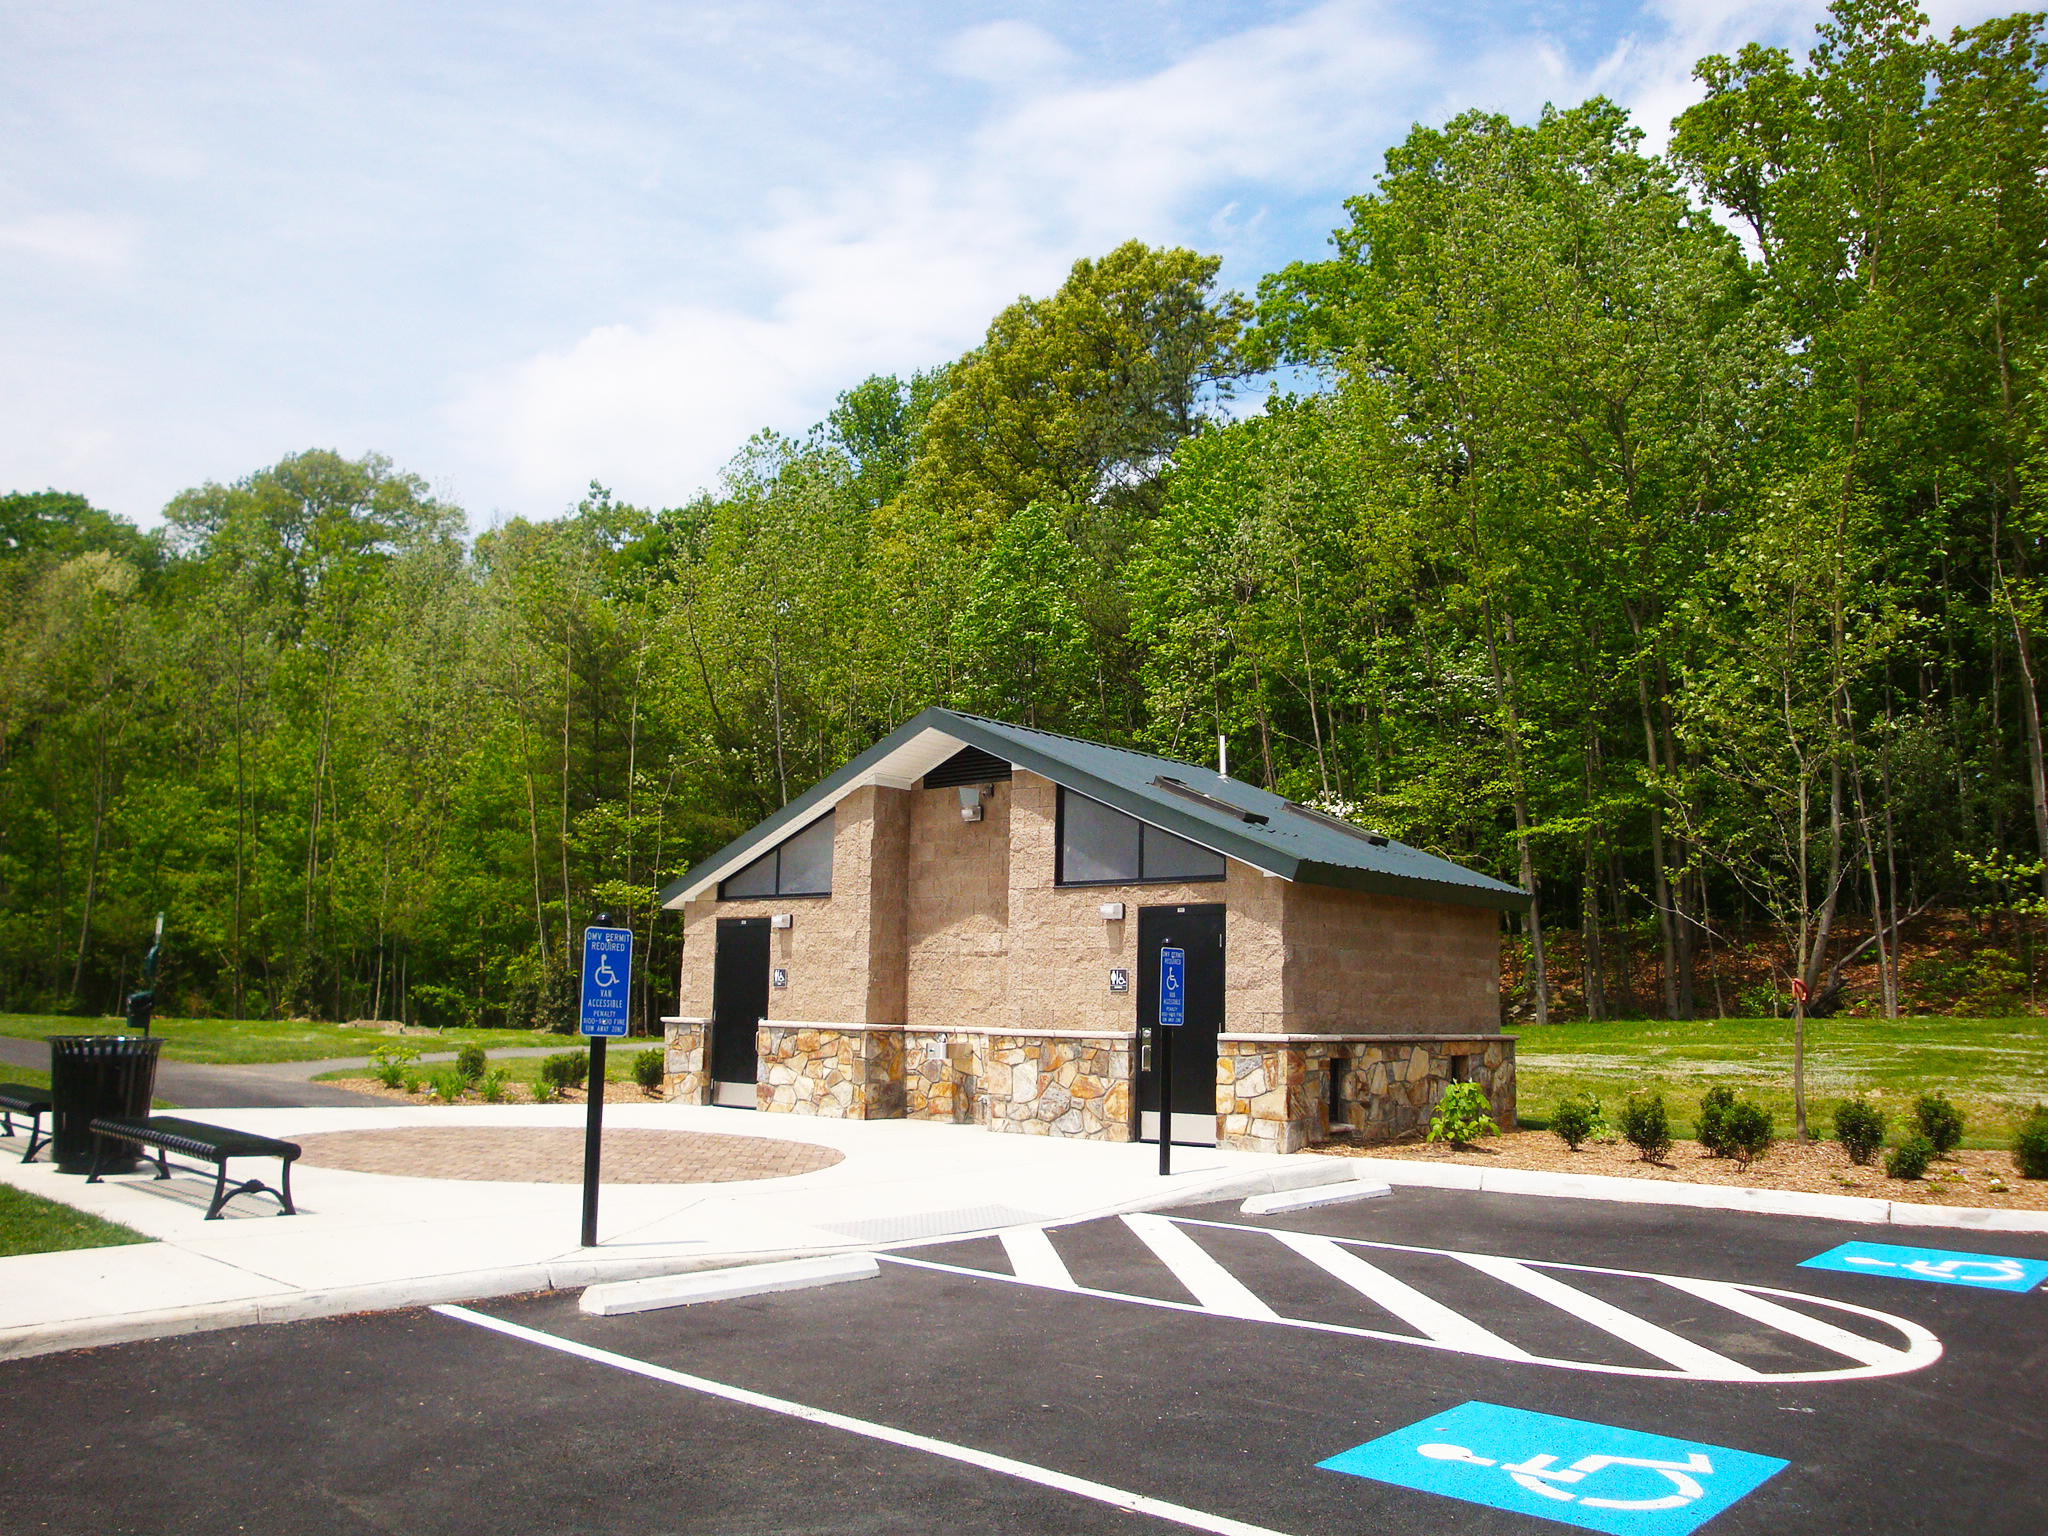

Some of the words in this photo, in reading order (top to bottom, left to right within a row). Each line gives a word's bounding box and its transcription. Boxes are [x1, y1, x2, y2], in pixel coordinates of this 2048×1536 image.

[587, 932, 602, 940] DMV
[606, 933, 630, 942] PERMIT
[591, 942, 625, 951] REQUIRED
[600, 989, 612, 997] VAN
[588, 999, 622, 1008] ACCESSIBLE
